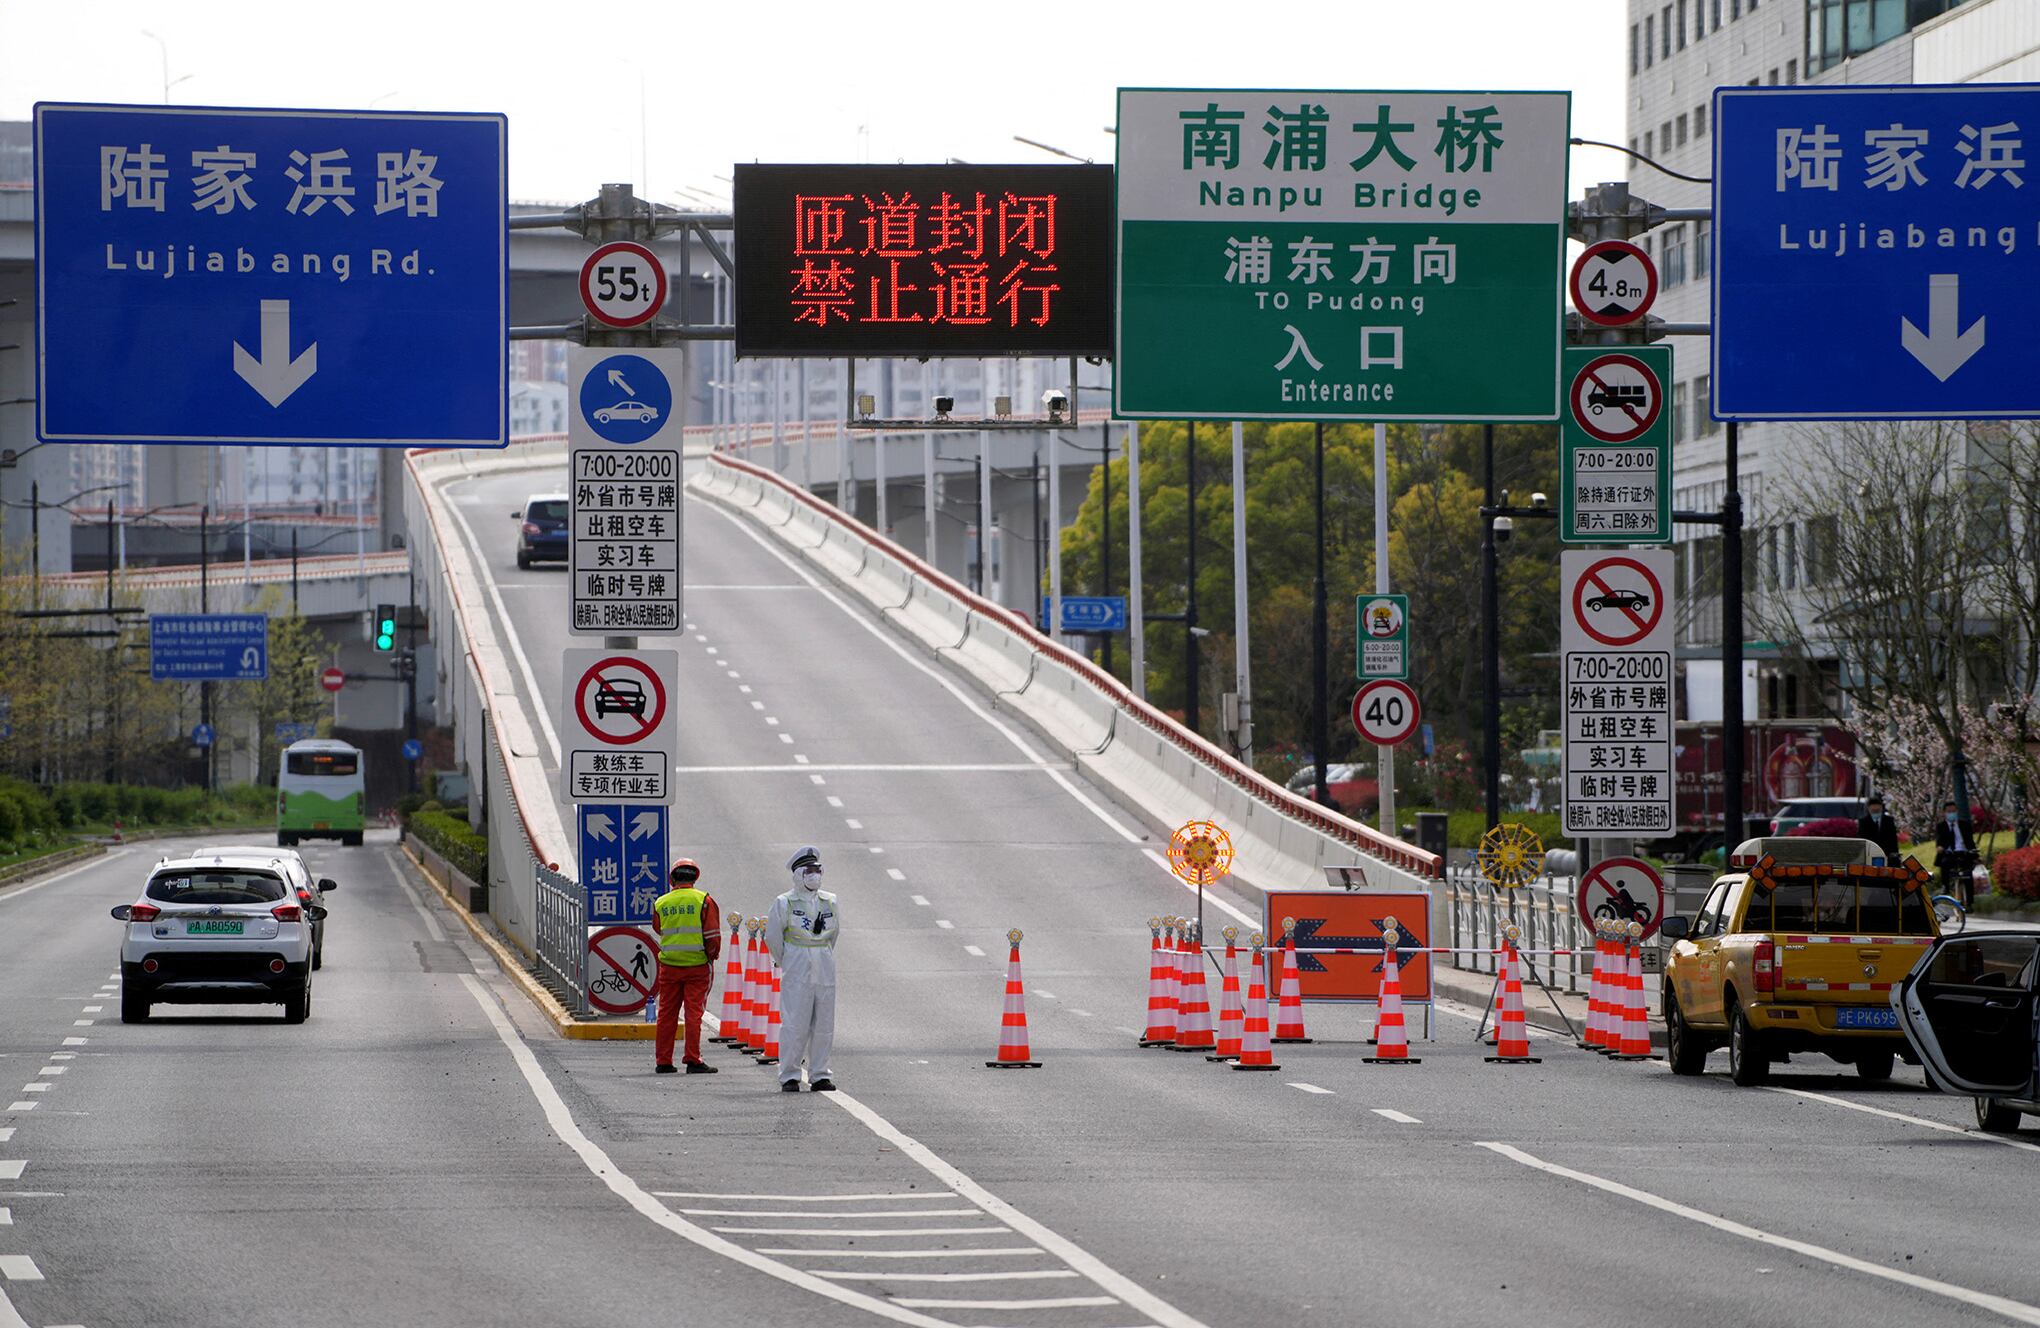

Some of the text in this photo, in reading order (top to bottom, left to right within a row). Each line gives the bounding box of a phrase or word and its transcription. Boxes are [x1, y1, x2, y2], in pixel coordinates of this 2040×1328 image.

[1179, 103, 1504, 174] 南浦大桥
[1776, 121, 2026, 192] 陆家浜
[100, 144, 445, 218] 陆家浜路
[1200, 181, 1482, 216] Nanpu Bridge
[793, 191, 1058, 259] 匝道封闭
[1780, 222, 2016, 257] Lujiabang
[106, 243, 436, 281] Lujiabang Rd.
[1223, 236, 1457, 285] 浦东方向
[596, 266, 650, 302] 55t
[791, 259, 1063, 327] 禁止通行
[1588, 269, 1642, 298] 4.8m
[1255, 292, 1424, 316] TO Pudong
[1273, 324, 1403, 371] 入口
[1281, 379, 1394, 402] Enterance
[581, 455, 671, 477] 7:00-20:00
[1578, 453, 1653, 468] 7:00-20:00
[577, 484, 675, 507] 外省市号牌
[1578, 486, 1655, 503] 除持通行证外
[588, 514, 665, 537] 出租空车
[598, 544, 655, 567] 实习车
[588, 574, 665, 597] 临时号牌
[1573, 656, 1662, 679] 7:00-20:00
[1570, 686, 1667, 709] 外省市号牌
[1365, 696, 1403, 726] 40
[1580, 715, 1657, 739] 出租空车
[593, 754, 644, 772] 教练车
[1590, 745, 1647, 769] 实习车
[577, 776, 660, 795] 专项作业车
[1580, 774, 1657, 798] 临时号牌
[592, 857, 619, 916] 地面
